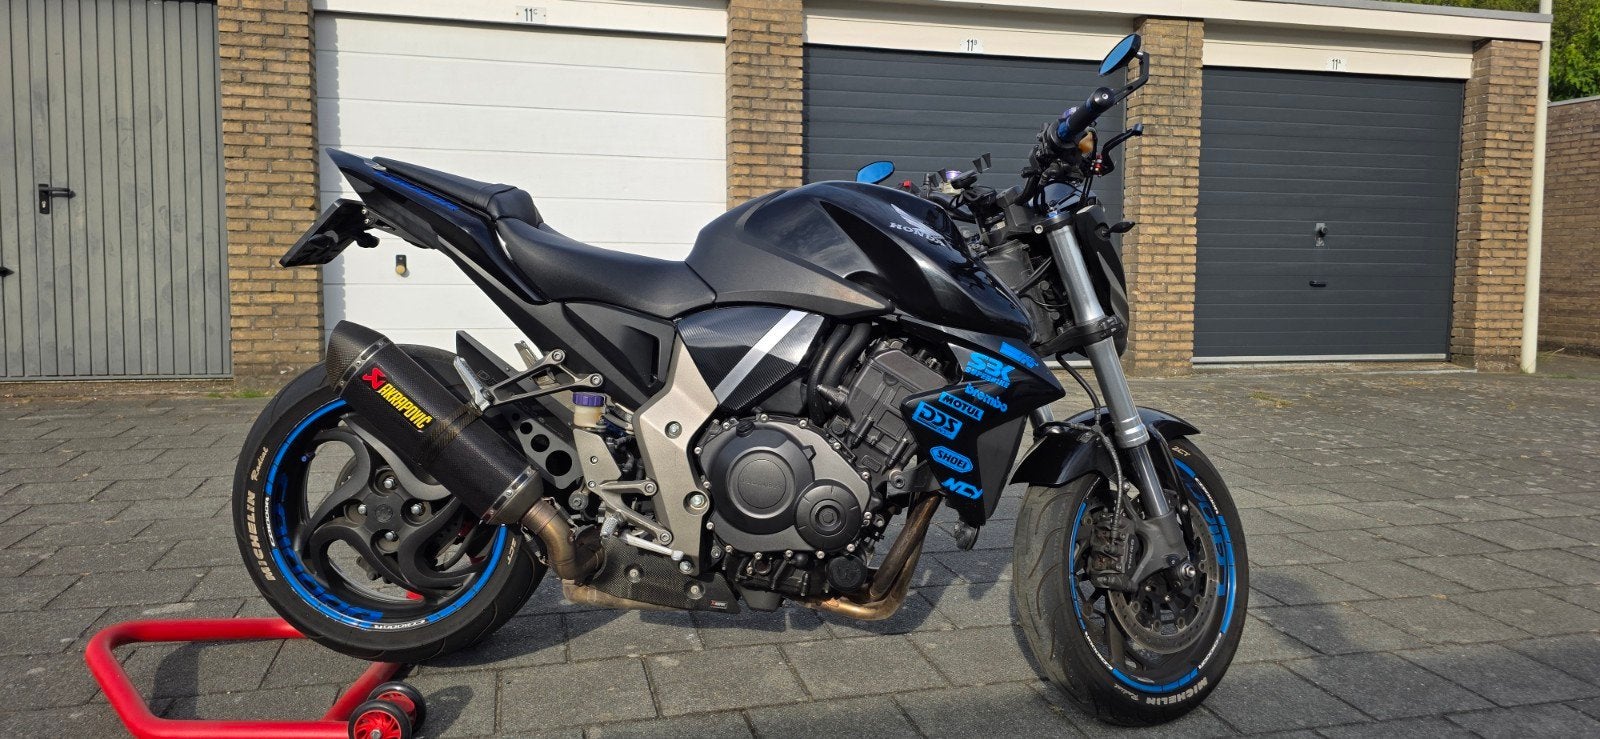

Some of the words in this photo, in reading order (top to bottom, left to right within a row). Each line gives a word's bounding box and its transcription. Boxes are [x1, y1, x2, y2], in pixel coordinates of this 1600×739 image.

[889, 222, 946, 247] HONDA
[967, 352, 1016, 383] SBK
[943, 395, 980, 418] MOTUL
[964, 382, 1008, 412] brembo
[250, 446, 269, 482] Radial
[937, 450, 968, 469] SHOEI
[246, 489, 277, 581] MICHELIN
[1145, 676, 1208, 706] MICHELIN
